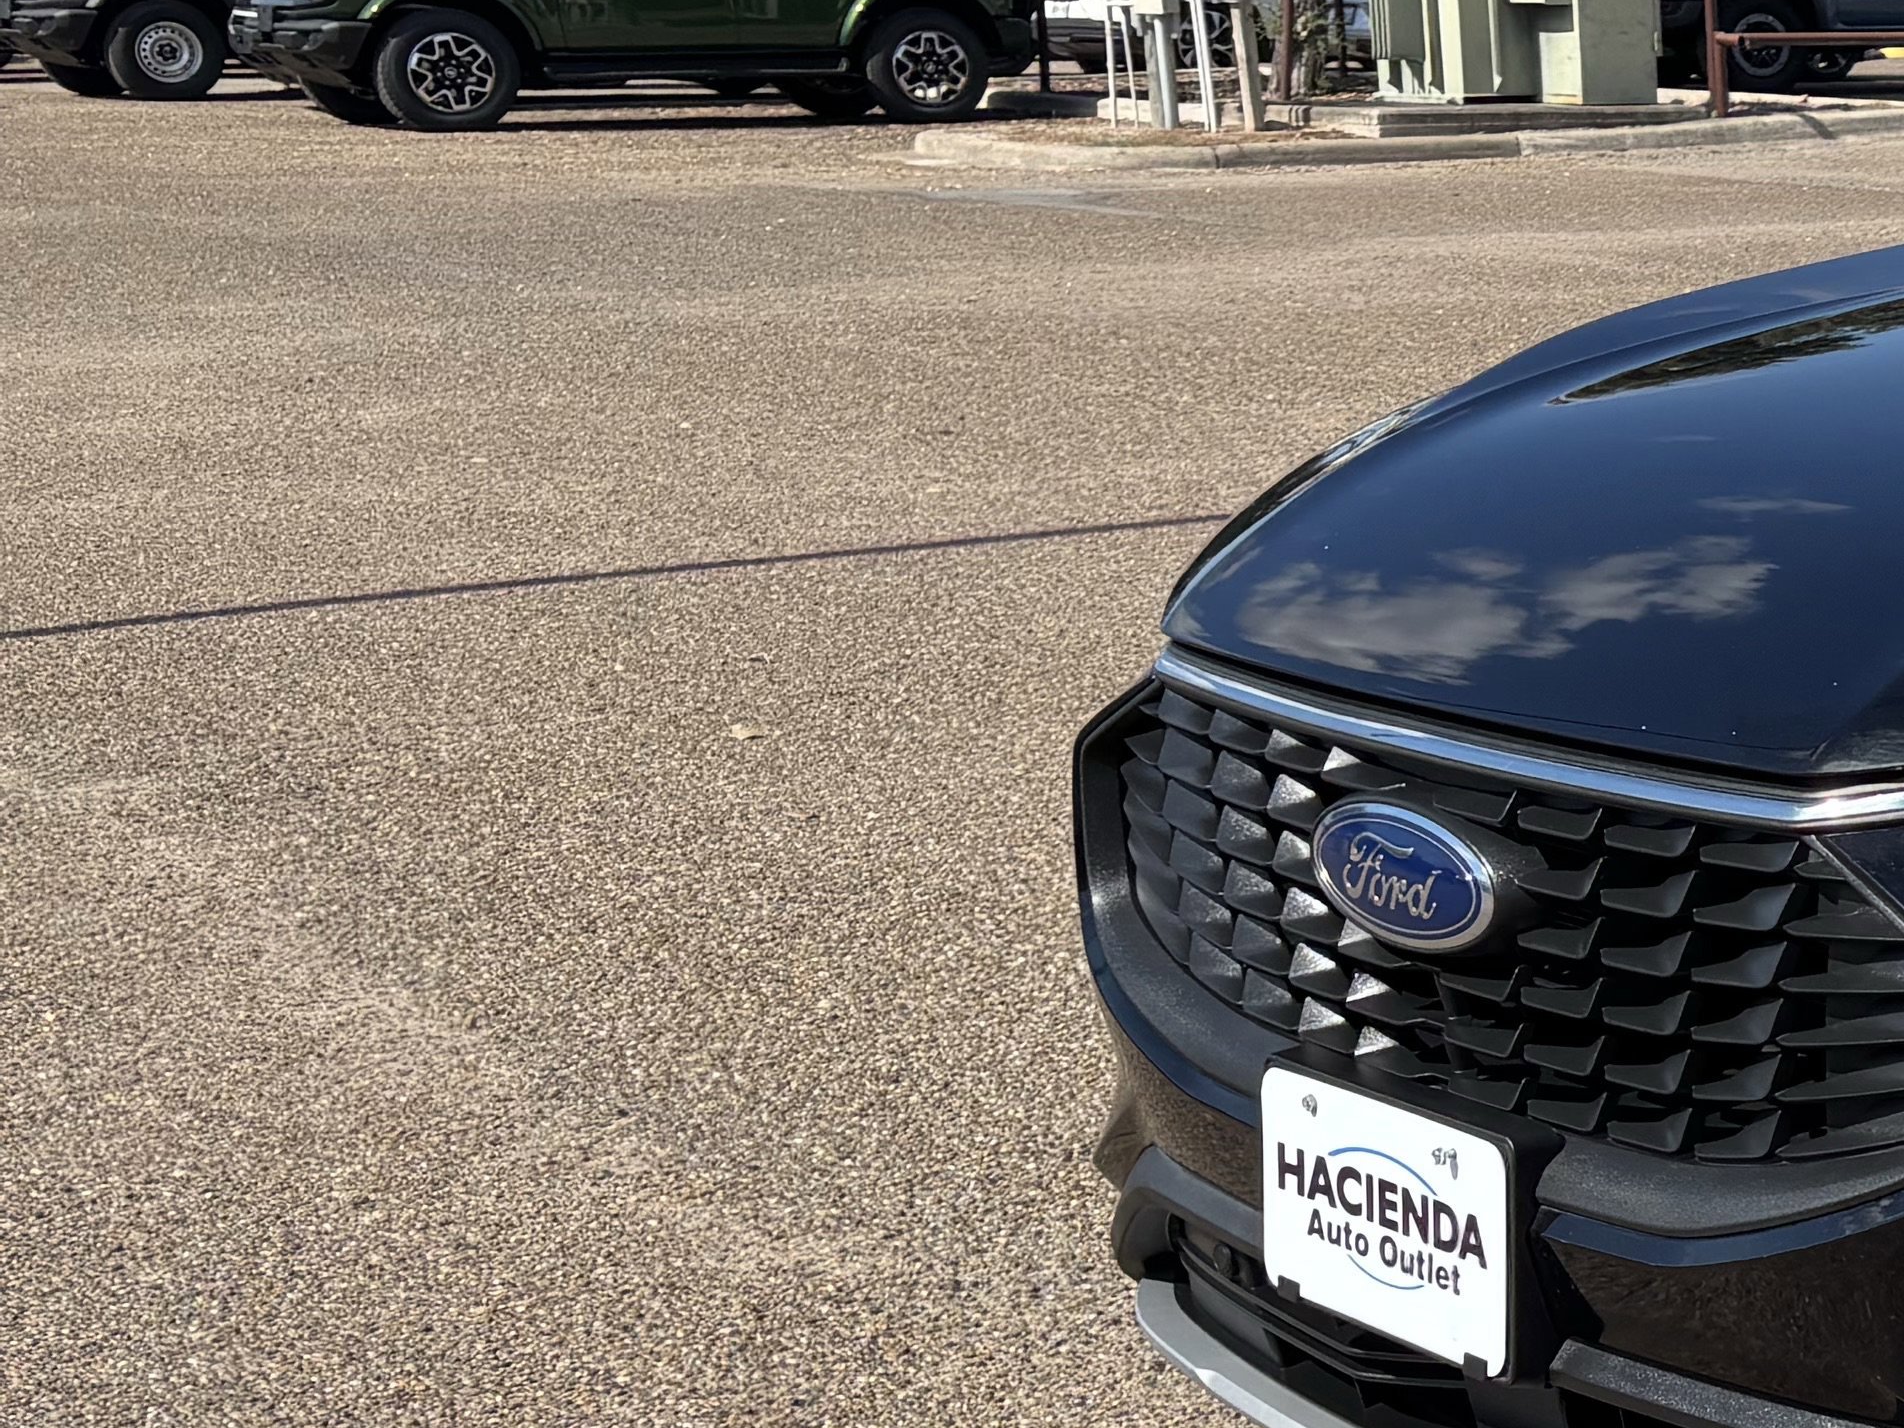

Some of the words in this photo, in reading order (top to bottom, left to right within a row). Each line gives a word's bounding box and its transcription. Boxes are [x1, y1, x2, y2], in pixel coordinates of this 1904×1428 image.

[1343, 831, 1442, 920] Ford
[1277, 1142, 1487, 1270] HACIENDA
[1307, 1208, 1369, 1257] Auto
[1379, 1236, 1460, 1296] Outlet
